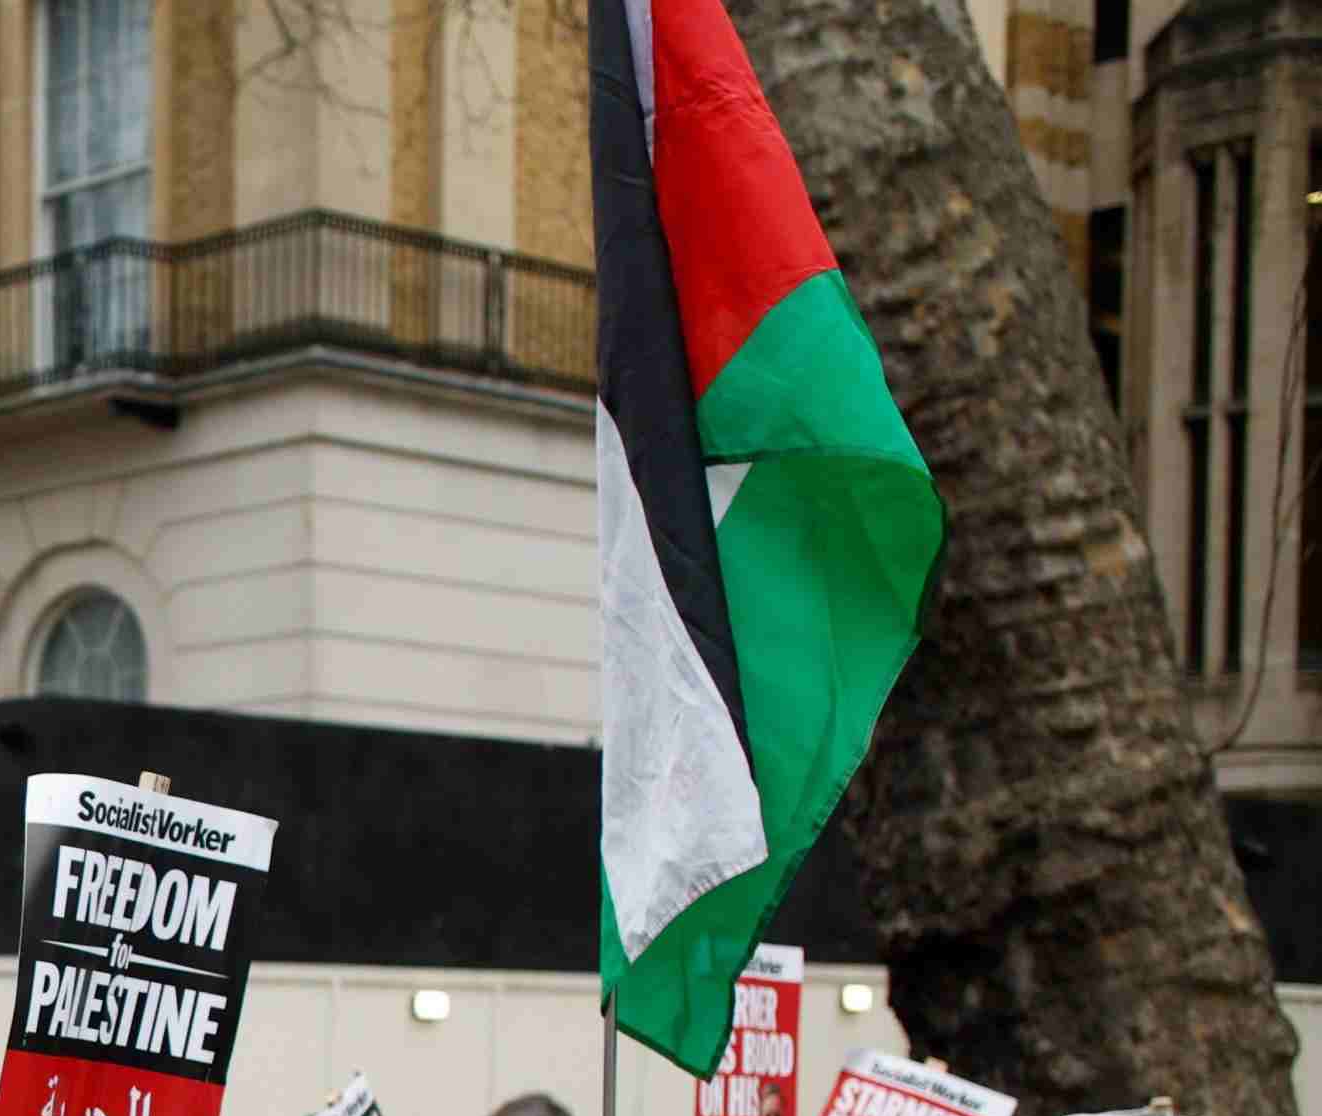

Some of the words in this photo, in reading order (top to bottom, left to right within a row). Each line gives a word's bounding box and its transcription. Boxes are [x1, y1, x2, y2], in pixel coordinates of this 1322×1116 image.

[78, 791, 158, 837] Socialist
[53, 845, 237, 951] FREEDOM
[25, 960, 227, 1064] PALESTINE
